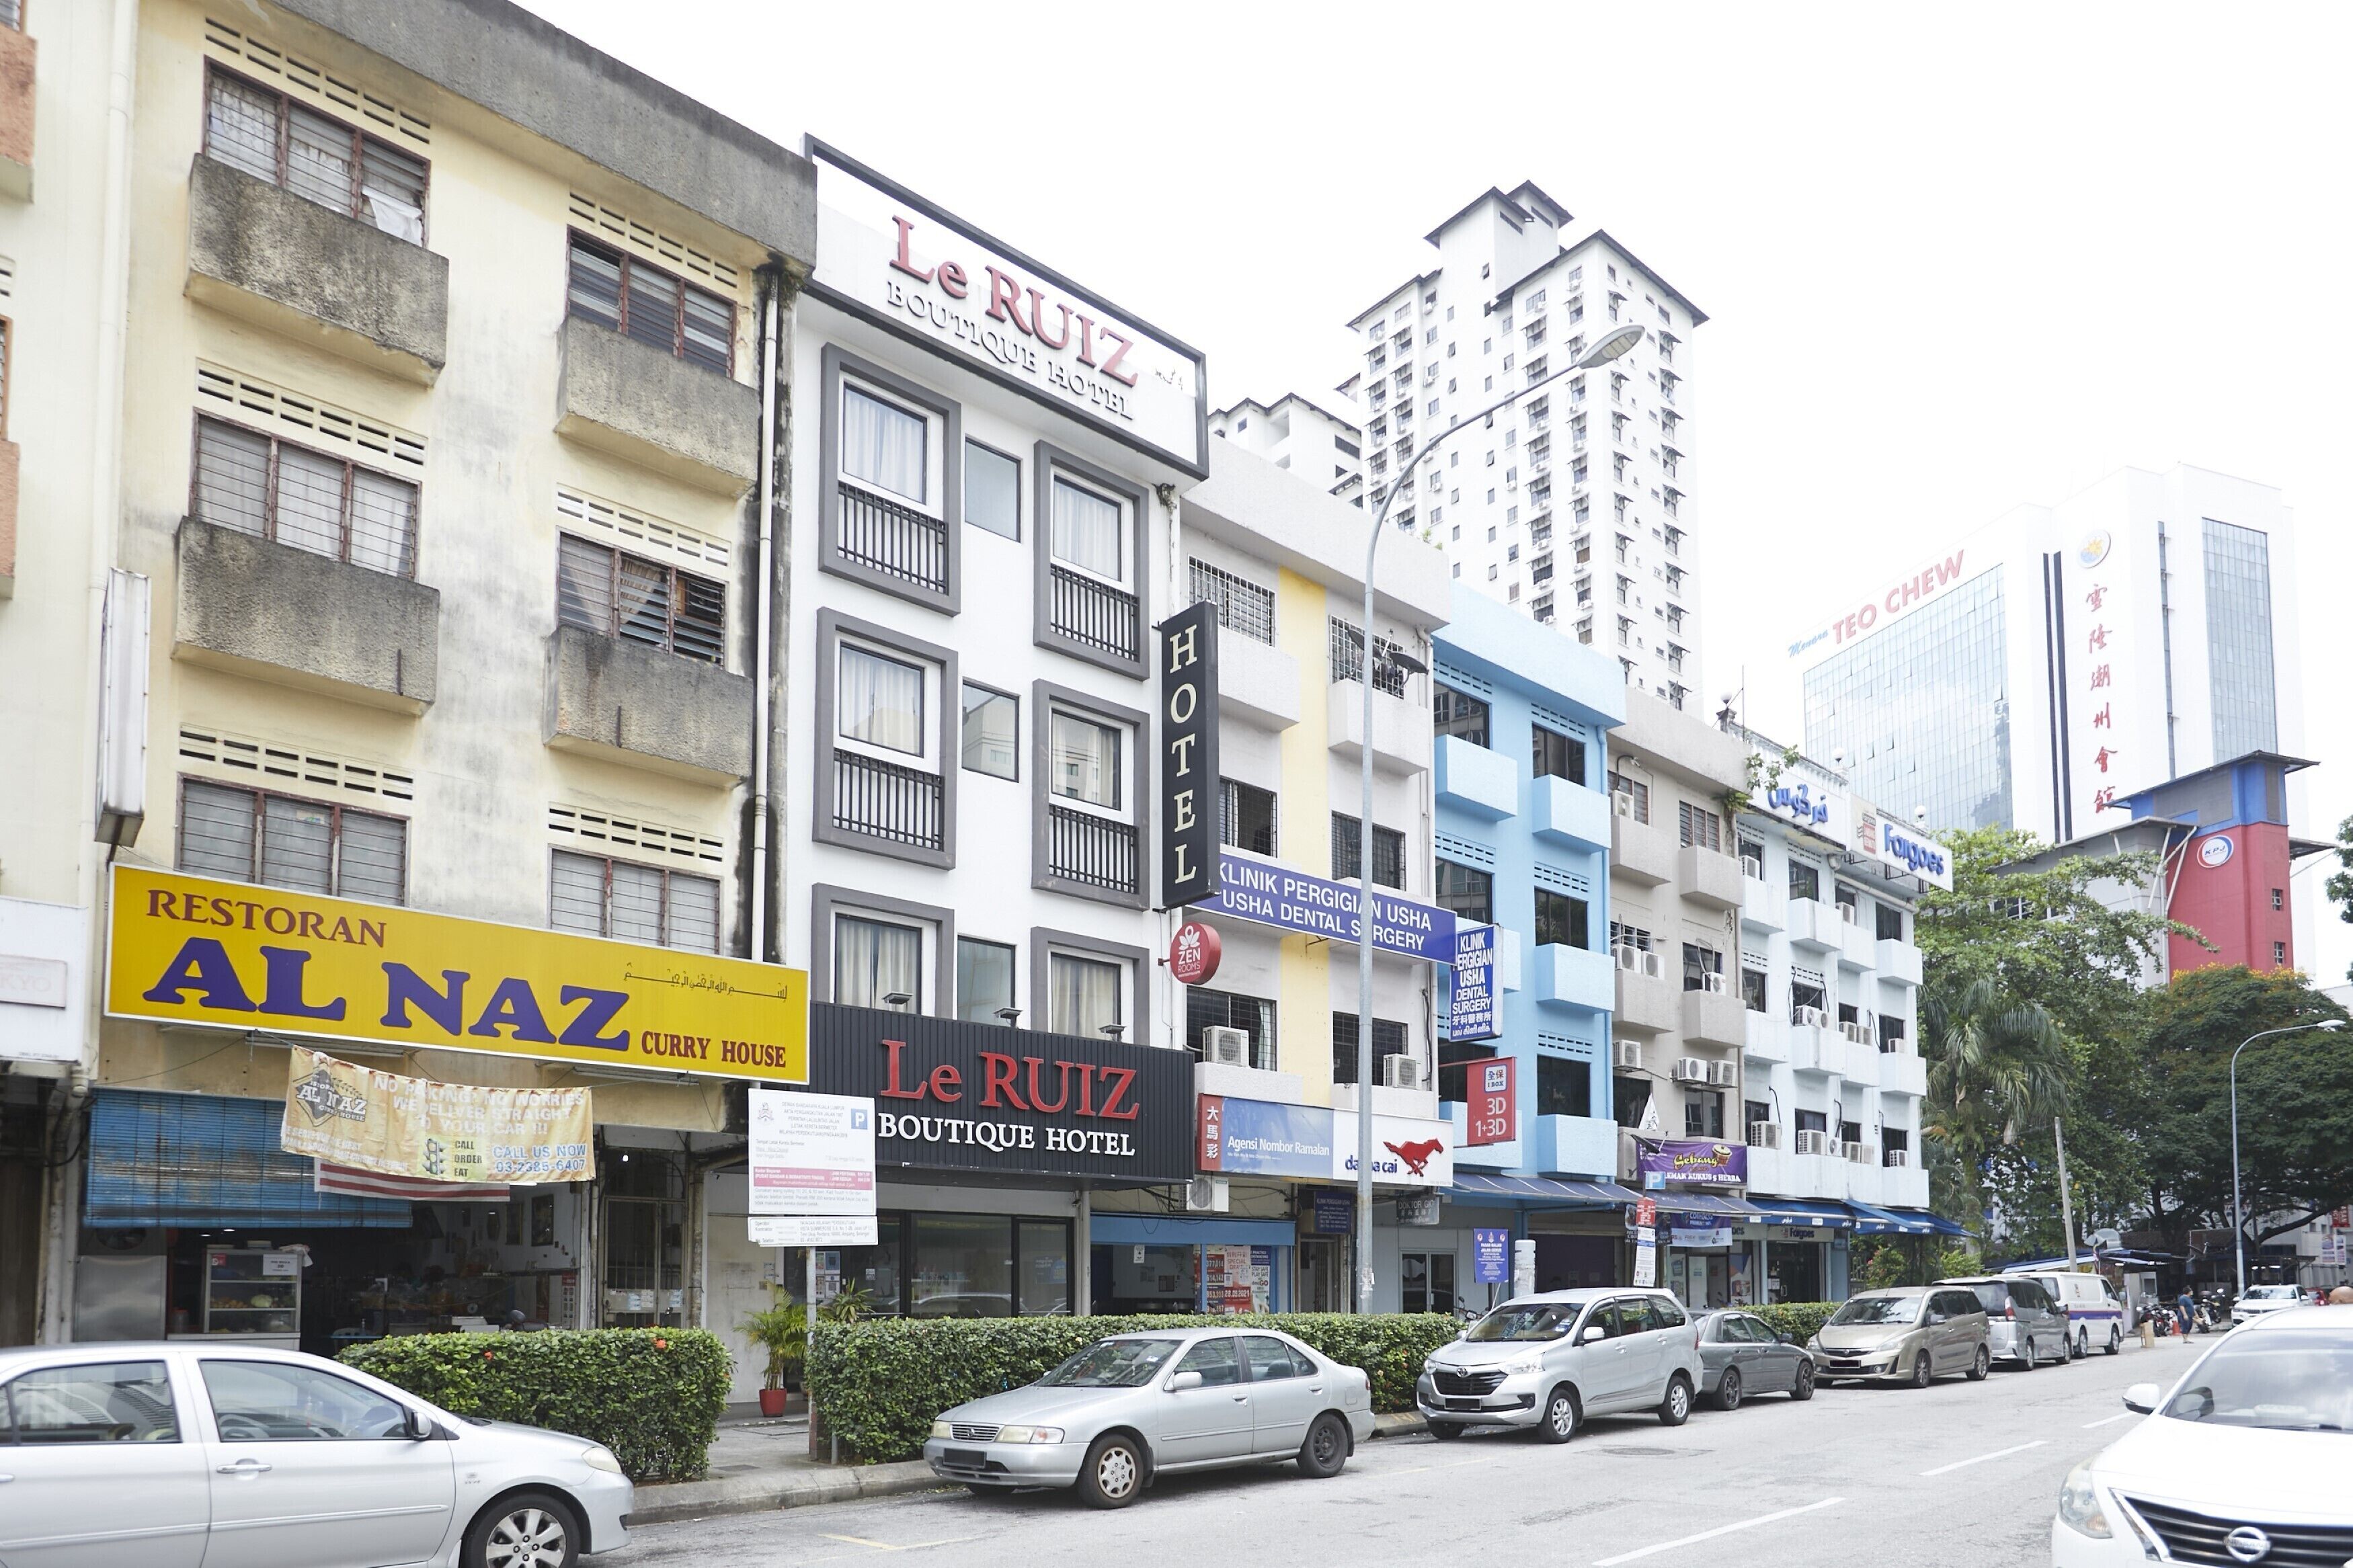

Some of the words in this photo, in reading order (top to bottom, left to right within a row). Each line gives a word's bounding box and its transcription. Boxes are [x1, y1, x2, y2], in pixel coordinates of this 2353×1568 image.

[889, 214, 969, 300] Le
[984, 265, 1139, 387] RUIZ
[887, 280, 1037, 373] BOUTIQUE
[1047, 360, 1135, 421] HOTEL
[1833, 604, 1877, 645] TEO
[1884, 548, 1964, 614] CHEW
[1169, 624, 1198, 885] HOTEL
[1884, 823, 1944, 876] Fargoes
[2204, 845, 2225, 856] KPJ
[1284, 878, 1382, 922] PERGIGIN
[1386, 905, 1432, 932] USHA
[146, 889, 388, 949] RESTORAN
[1222, 888, 1274, 917] USHA
[1280, 903, 1345, 934] DENTAL
[1350, 920, 1425, 951] SRGERY
[1460, 932, 1485, 952] KLINIK
[1178, 948, 1201, 965] ZEN
[1458, 948, 1492, 971] ERGIGIAN
[1178, 962, 1201, 973] ROOMS
[1460, 967, 1485, 987] USHA
[143, 937, 347, 1022] AL
[381, 960, 632, 1052] NAZ
[1456, 985, 1488, 1001] DENTAL
[1453, 997, 1491, 1014] SURGERY
[641, 1030, 711, 1060] CURRY
[721, 1040, 786, 1068] HOUSE
[879, 1039, 963, 1103] Le
[978, 1050, 1140, 1120] RUIZ
[296, 1085, 321, 1103] AL
[327, 1091, 368, 1115] NAZ
[374, 1075, 399, 1093] NO
[485, 1094, 506, 1106] NO
[516, 1093, 584, 1106] WORRIES
[393, 1095, 417, 1112] WE
[492, 1108, 571, 1121] STRAIGHT
[1486, 1097, 1507, 1115] 3D
[337, 1112, 366, 1122] HOUSE
[441, 1118, 485, 1134] YOUR
[493, 1122, 526, 1135] CAR
[854, 1112, 866, 1128] P
[877, 1112, 1035, 1153] BOUTIQUE
[1045, 1127, 1135, 1156] HOTEL
[1206, 1105, 1219, 1159] 大馬彩
[1476, 1118, 1507, 1137] 1+3D
[454, 1140, 475, 1150] CALL
[493, 1145, 527, 1159] CALL
[532, 1145, 551, 1159] US
[556, 1144, 586, 1157] NOW
[1228, 1135, 1257, 1151] Agensi
[1260, 1139, 1293, 1153] Nombor
[1295, 1142, 1330, 1156] Ramalan
[454, 1155, 483, 1164] ORDER
[495, 1159, 586, 1173] 03-2385-6407
[1382, 1158, 1398, 1173] cai
[1673, 1151, 1719, 1171] Gebang
[454, 1168, 469, 1178] EAT
[1649, 1173, 1661, 1188] P
[1665, 1172, 1686, 1180] EMAK
[1688, 1172, 1712, 1182] KUKUS
[1718, 1173, 1741, 1183] HERBA
